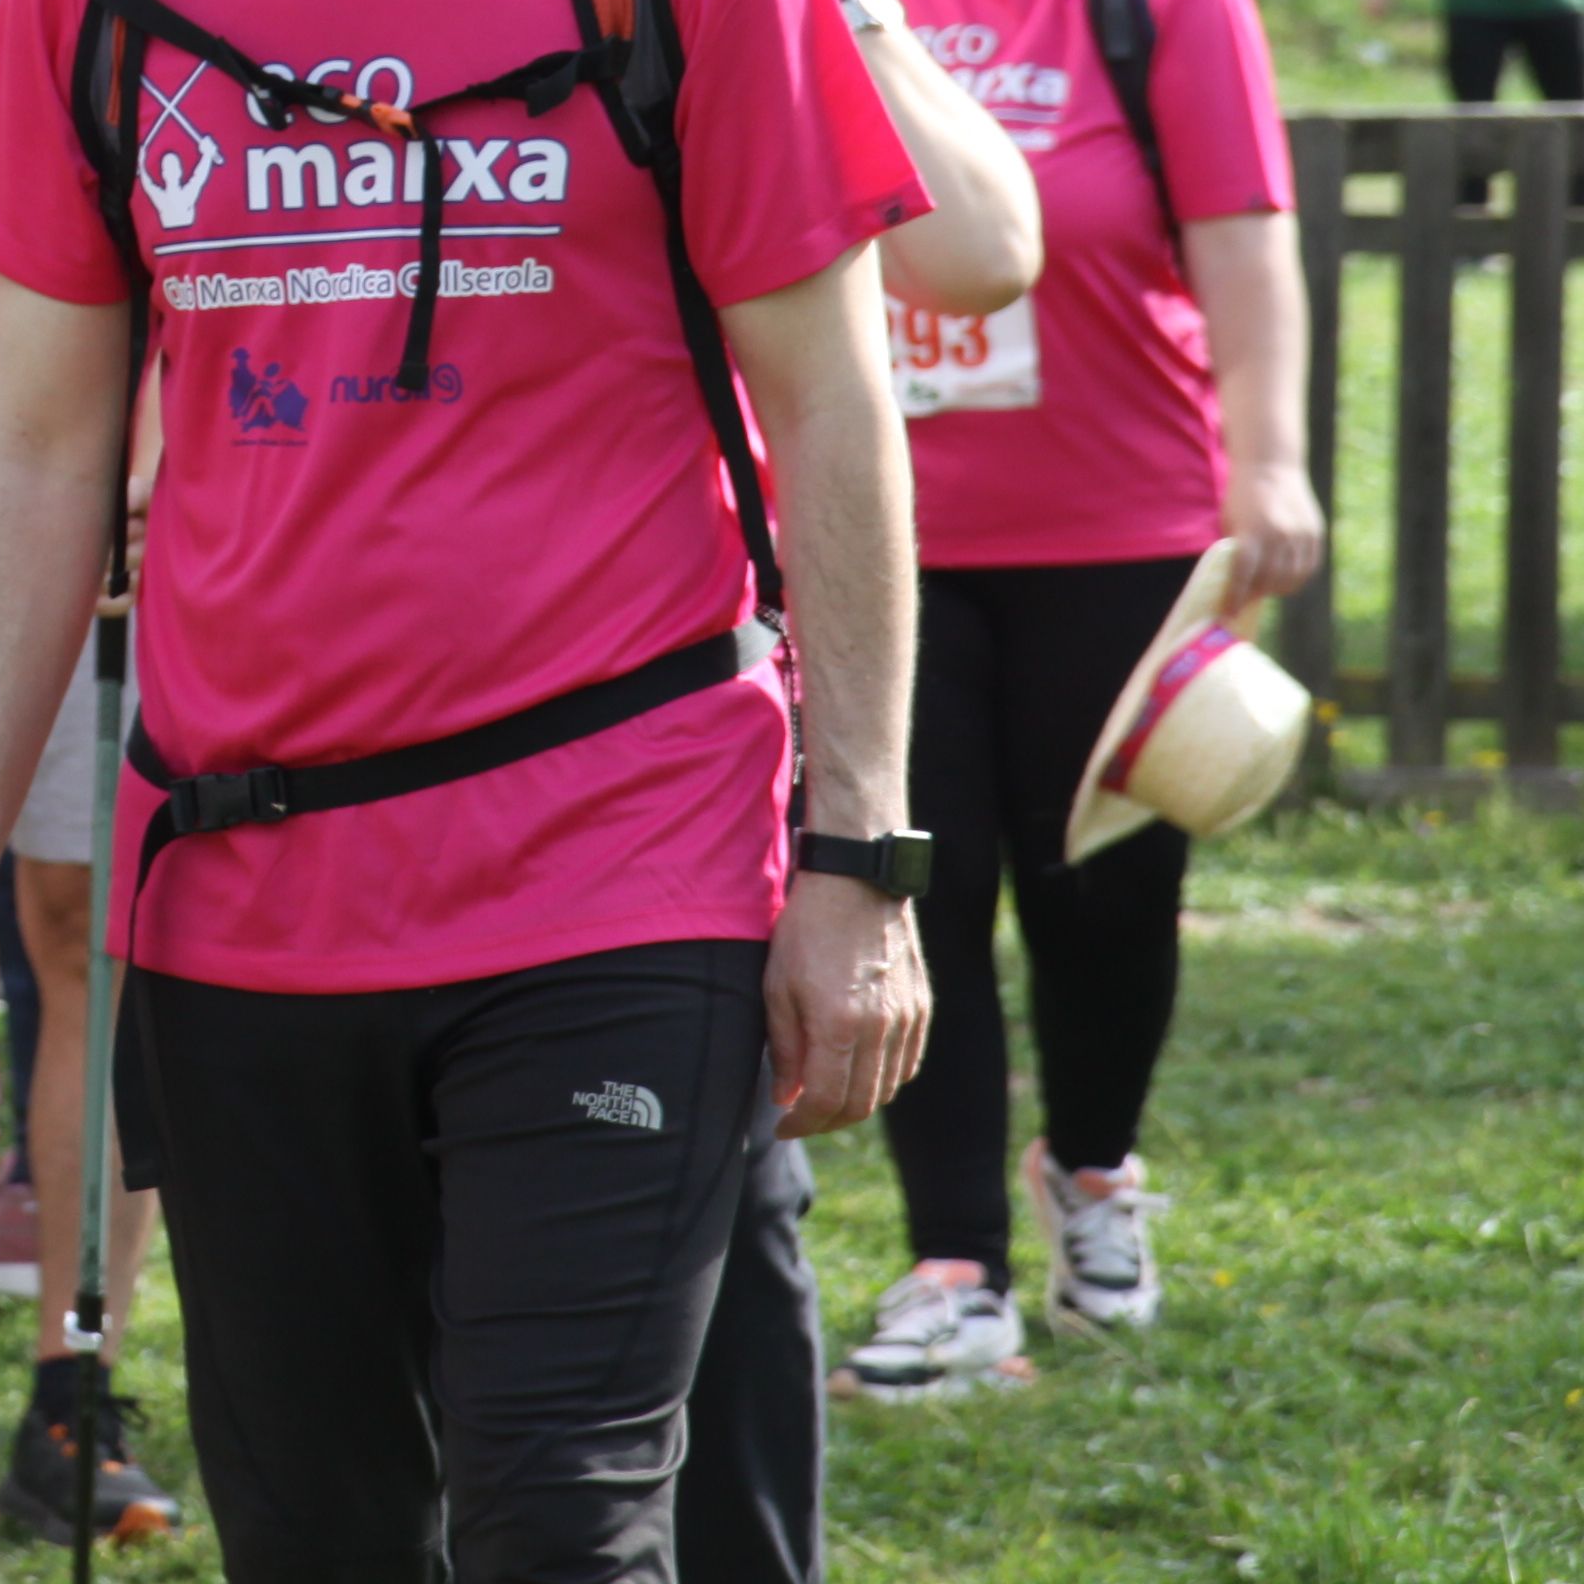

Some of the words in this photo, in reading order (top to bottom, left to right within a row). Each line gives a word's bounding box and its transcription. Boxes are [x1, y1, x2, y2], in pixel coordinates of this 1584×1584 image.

[245, 138, 570, 212] marxa
[198, 273, 284, 309] Marxa
[287, 263, 394, 305] Nòrdica
[397, 258, 554, 299] Cllserola
[601, 1079, 636, 1098] THE
[572, 1090, 634, 1112] NORTH
[585, 1105, 632, 1125] FACE
